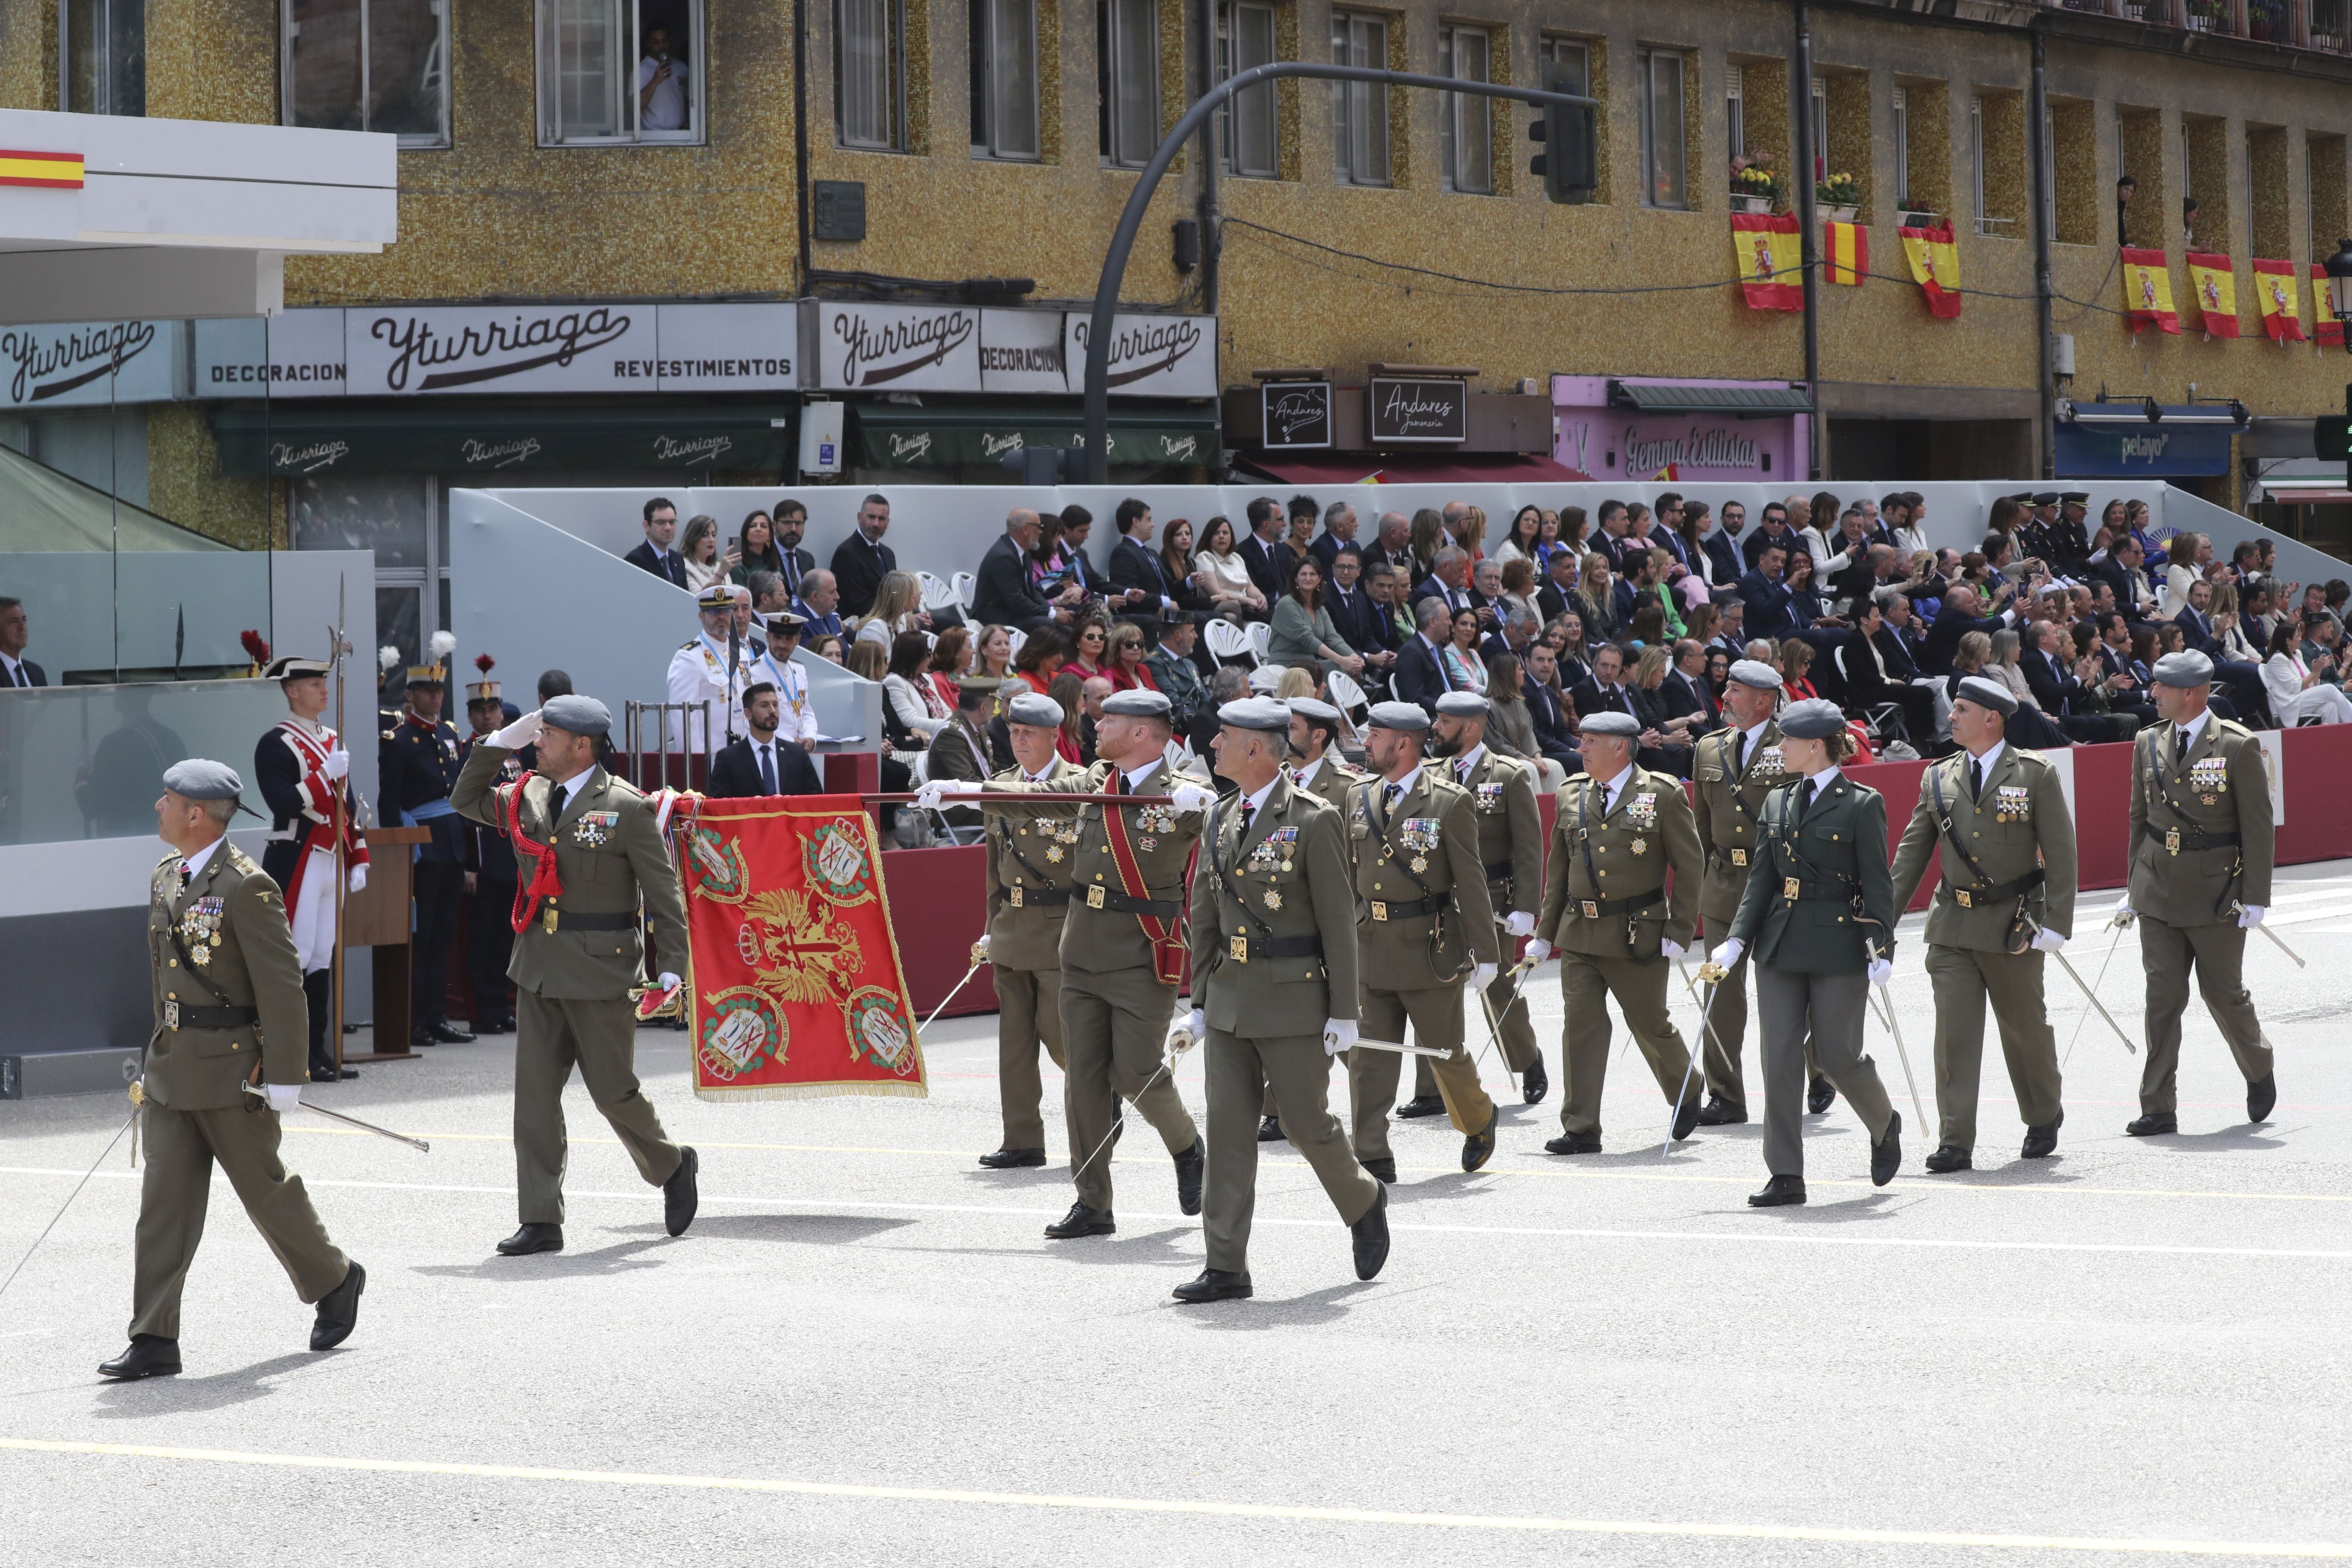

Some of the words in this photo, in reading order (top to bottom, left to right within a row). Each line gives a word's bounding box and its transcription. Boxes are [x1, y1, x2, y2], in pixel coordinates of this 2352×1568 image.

[2, 321, 154, 403] Yturriaga
[371, 308, 630, 391] Yturriaga
[834, 310, 973, 386] Yturriaga
[211, 364, 346, 382] DECORACION
[614, 359, 791, 377] REVESTIMIENTOS
[1275, 399, 1323, 420] Andares
[1384, 384, 1453, 422] Andares
[1626, 425, 1689, 477] Gemma
[1689, 426, 1758, 467] Estilistas
[2122, 434, 2162, 464] pelayo
[773, 1002, 789, 1031] INFANTERIA
[783, 1031, 789, 1039] DE
